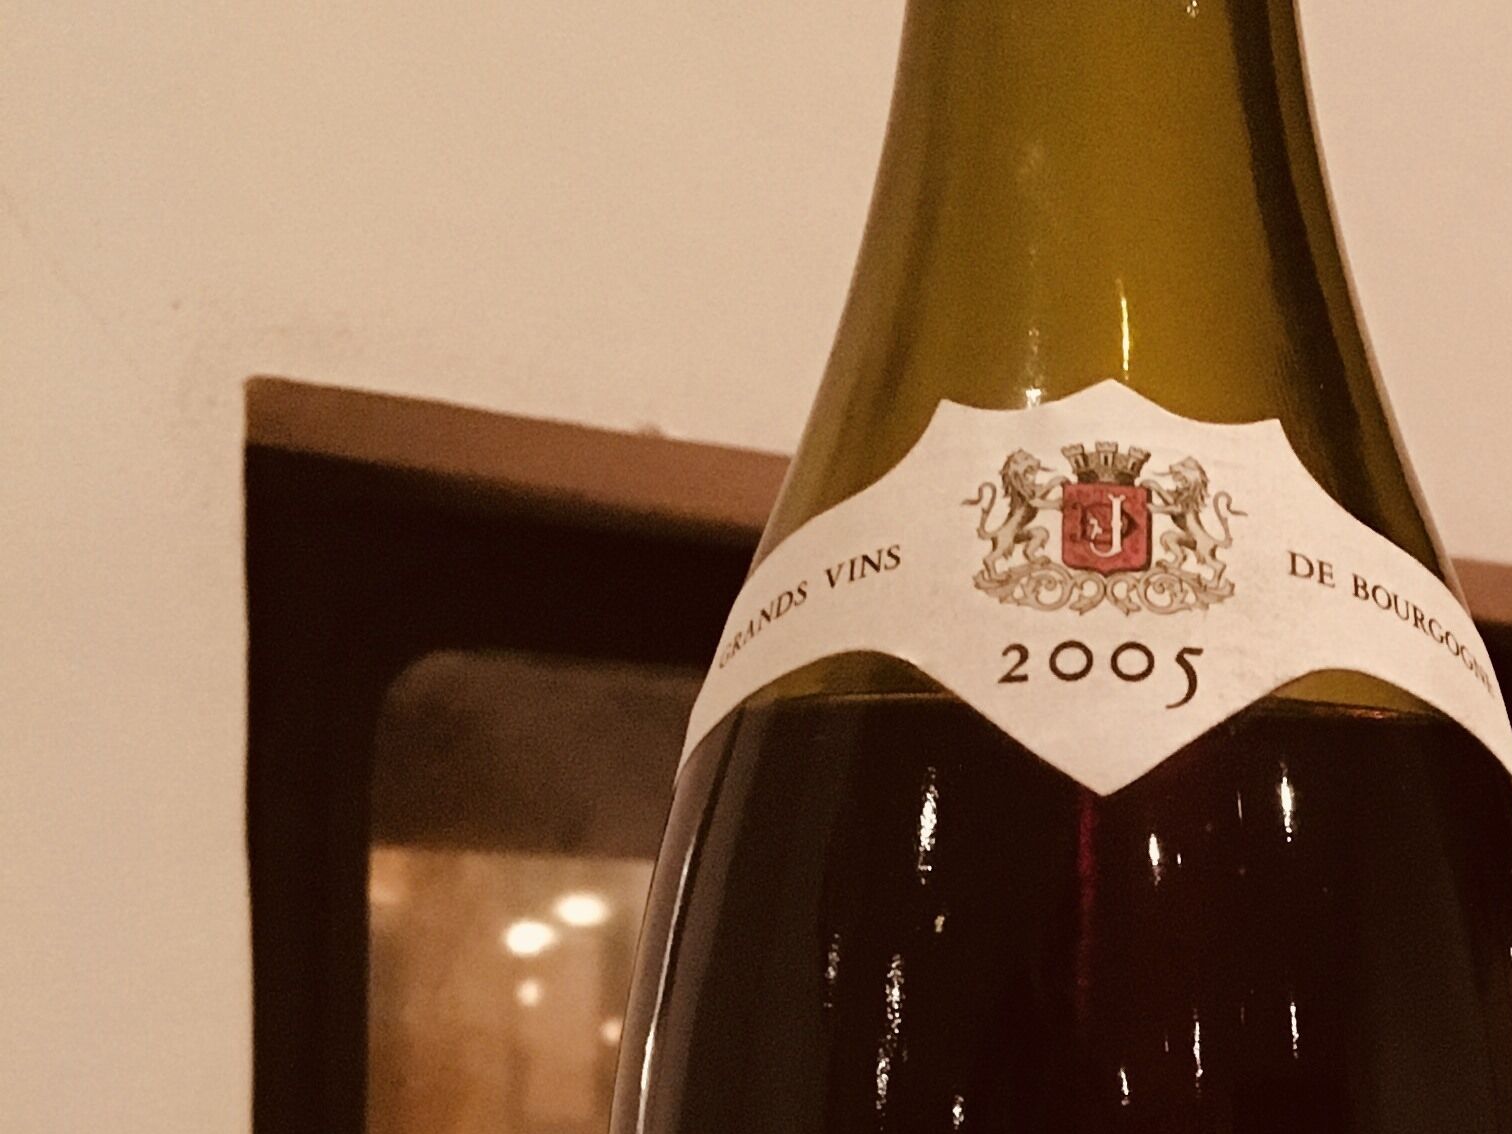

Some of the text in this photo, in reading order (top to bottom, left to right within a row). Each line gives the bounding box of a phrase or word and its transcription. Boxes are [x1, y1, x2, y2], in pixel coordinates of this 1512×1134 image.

[719, 580, 808, 669] GRANDS
[824, 544, 901, 589] VINS
[1288, 551, 1335, 588] DE
[998, 640, 1204, 709] 2005
